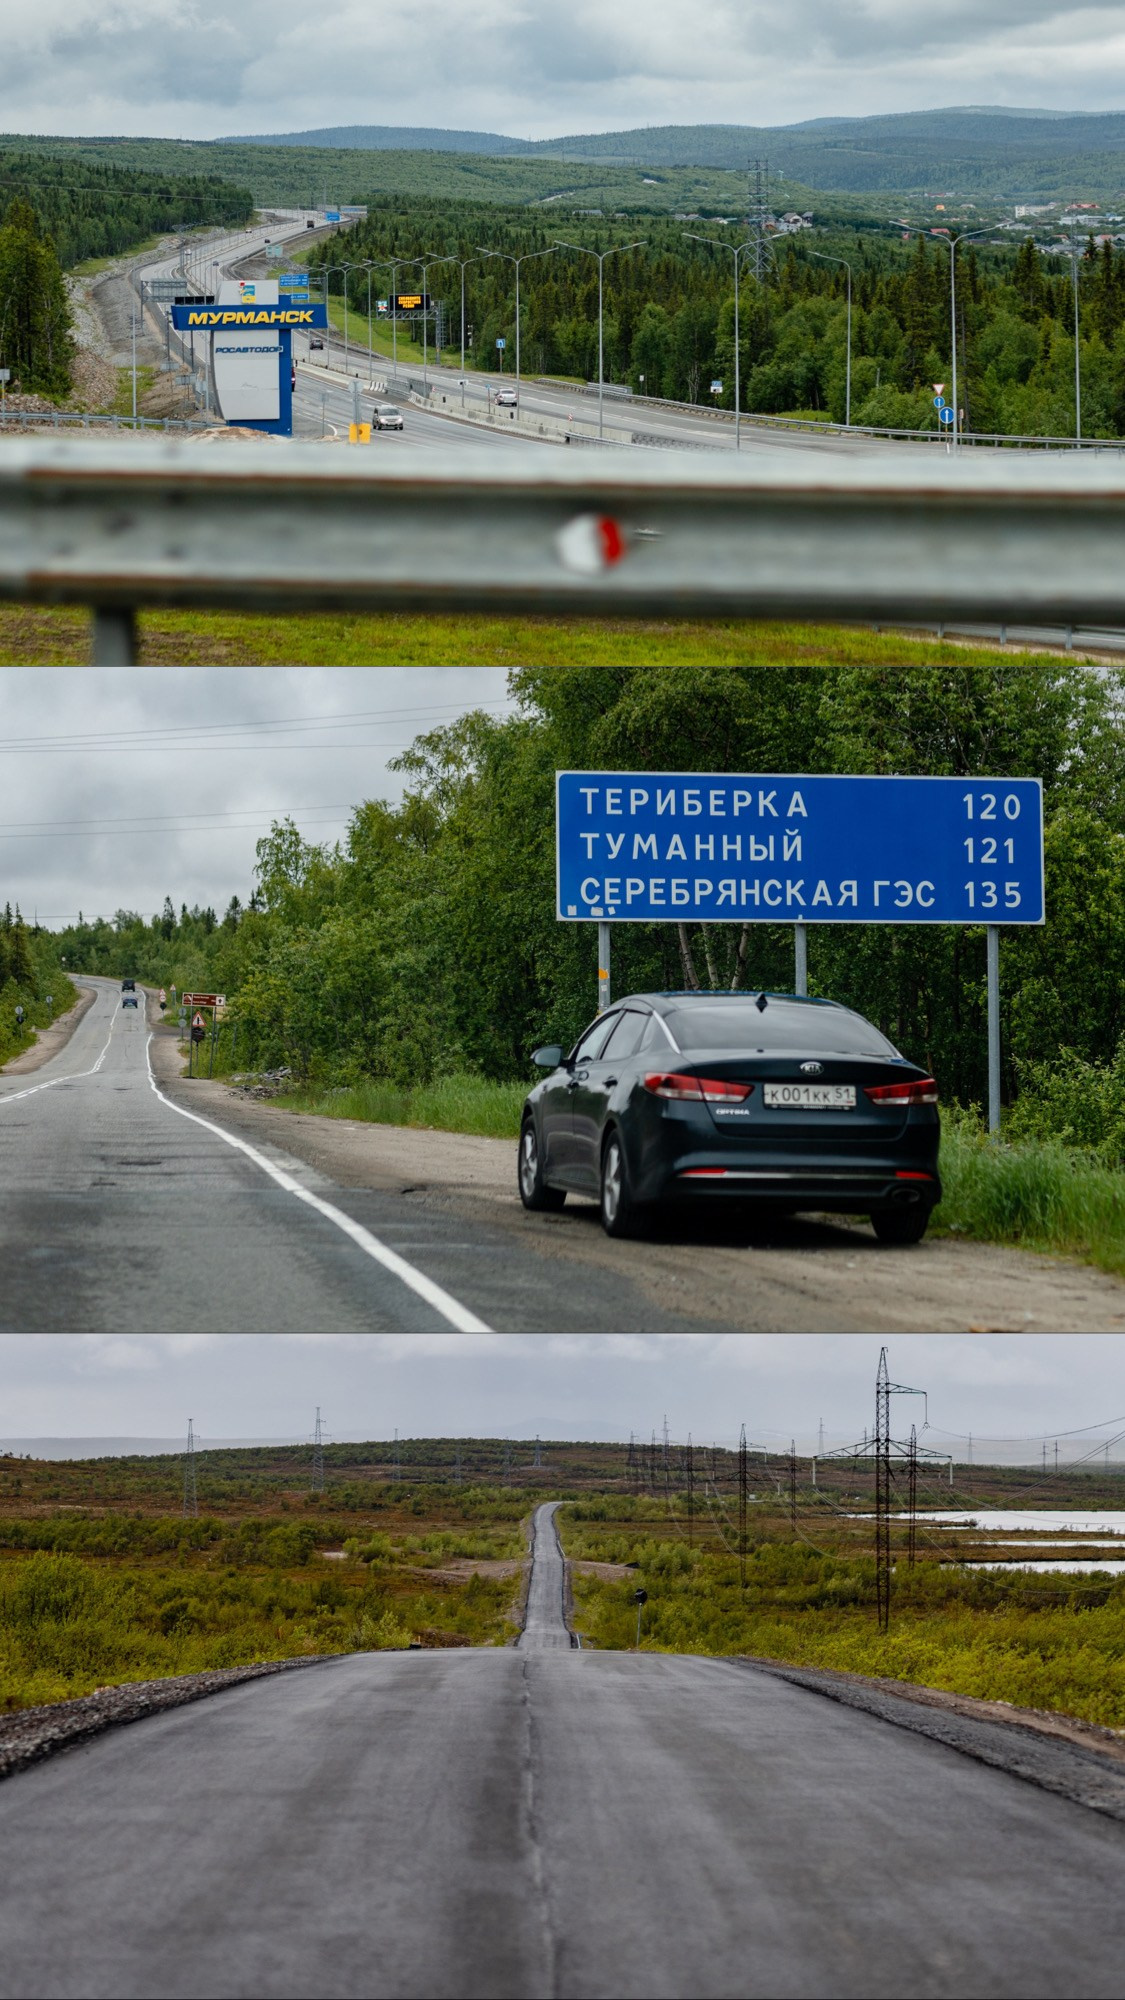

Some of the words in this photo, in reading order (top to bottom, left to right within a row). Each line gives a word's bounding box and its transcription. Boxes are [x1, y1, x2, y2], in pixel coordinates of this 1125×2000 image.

[188, 310, 314, 325] МУРМАНСК
[579, 787, 808, 817] ТЕРИБЕРКА
[963, 793, 1021, 820] 120
[579, 828, 802, 862] ТУМАННЫЙ
[963, 837, 1014, 864] 121
[580, 877, 858, 907] СЕРЕБРЯНСКАЯ
[873, 880, 935, 908] ГЭС
[964, 881, 1022, 908] 135
[803, 1064, 822, 1073] KIA
